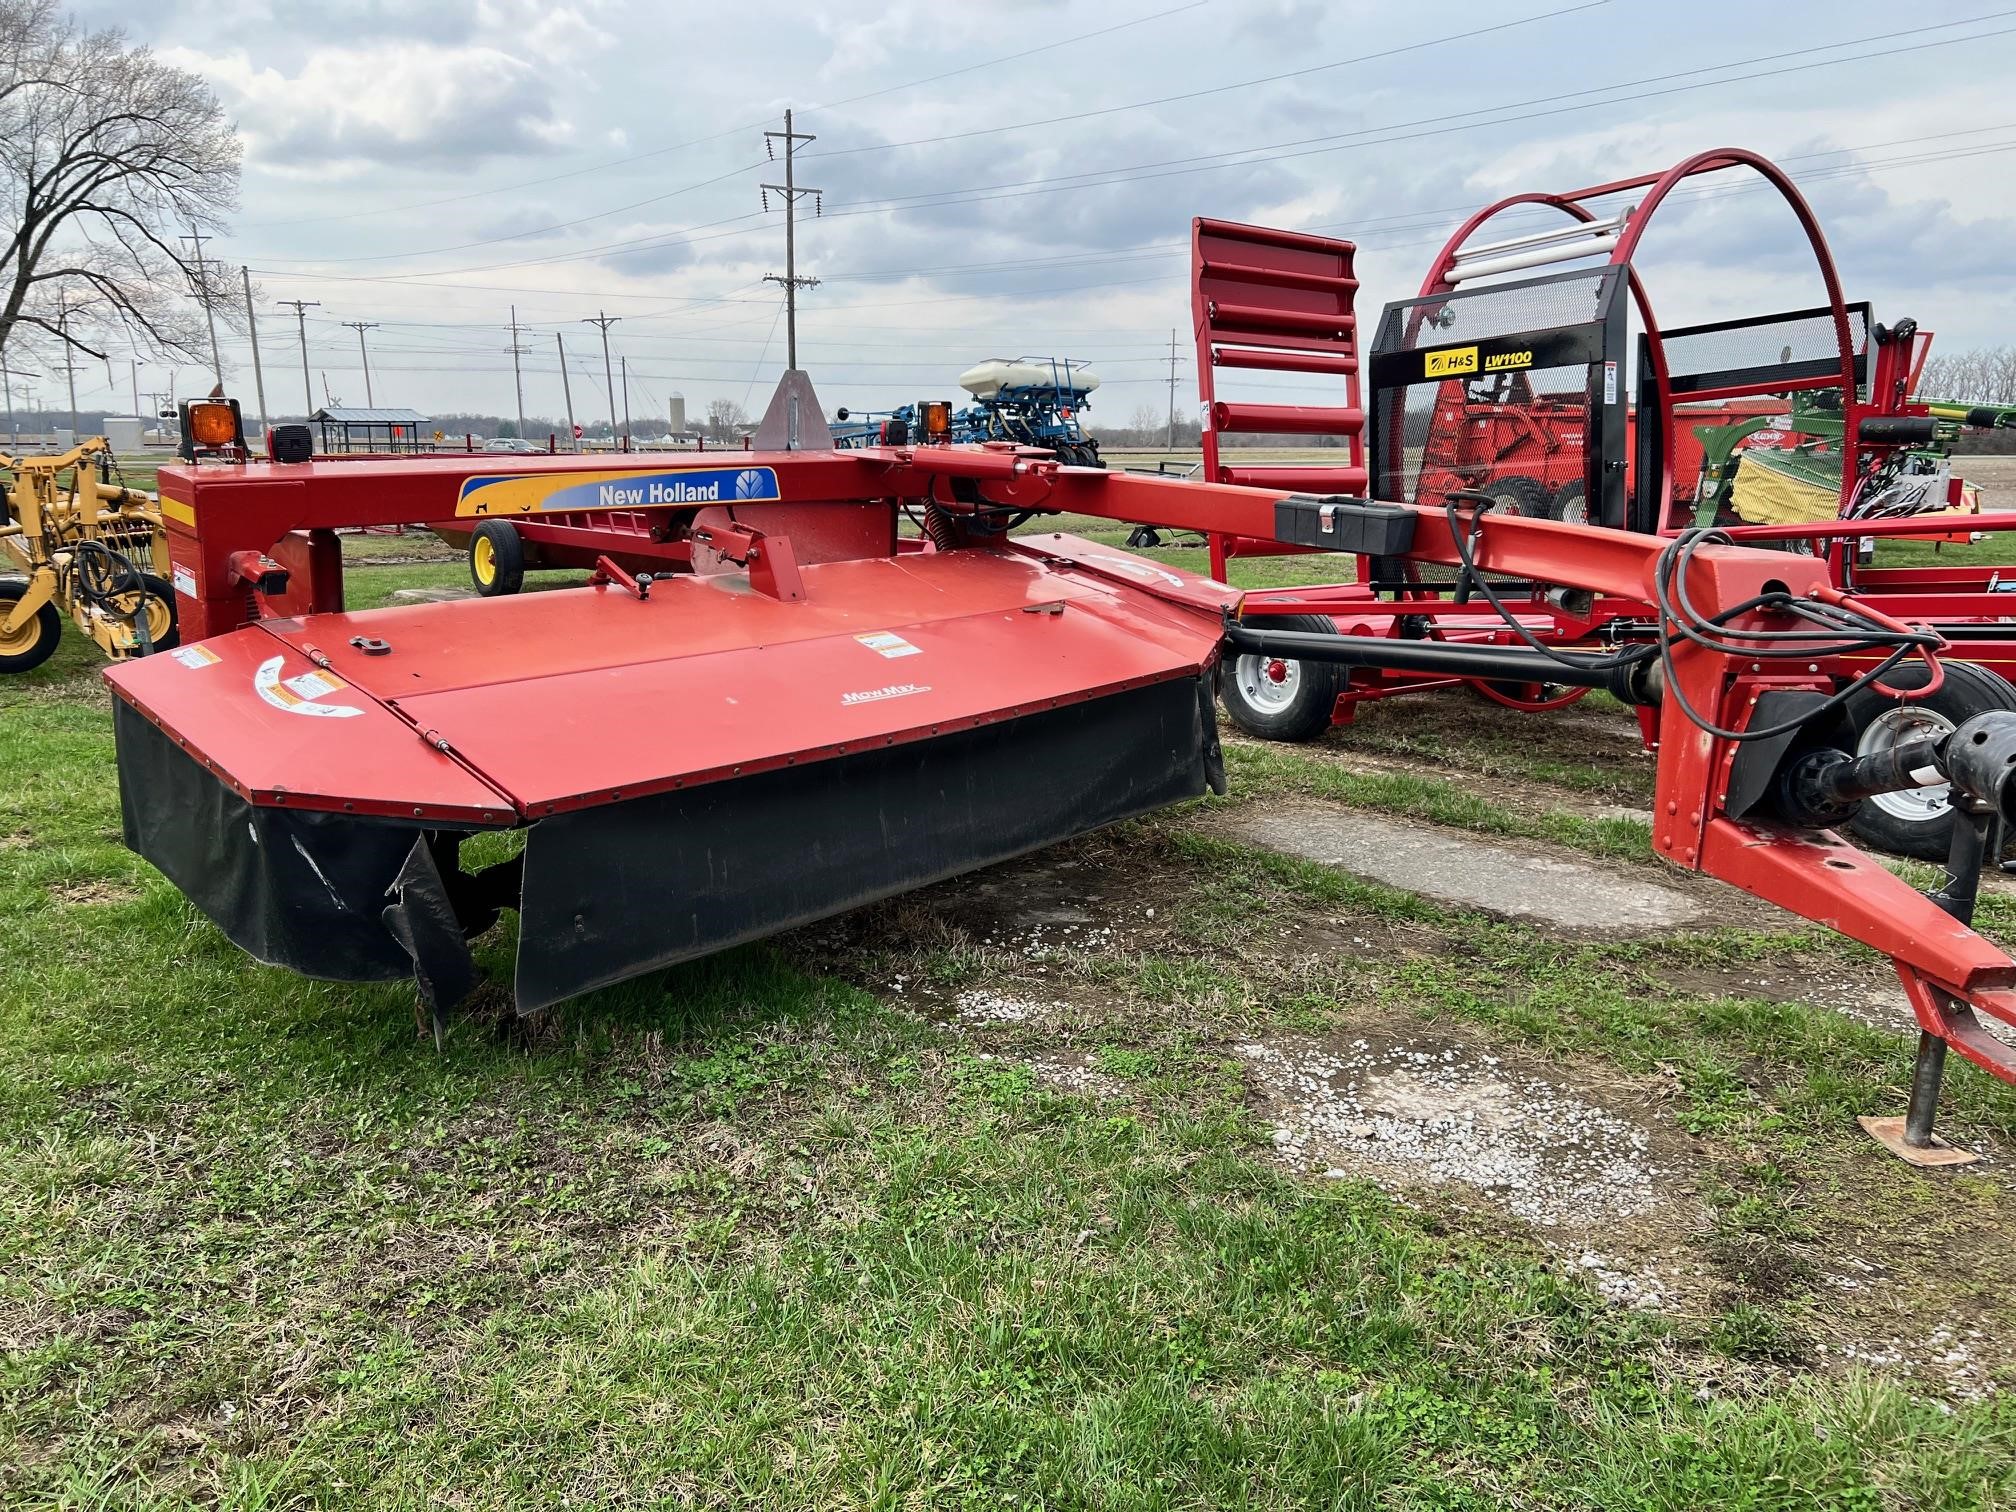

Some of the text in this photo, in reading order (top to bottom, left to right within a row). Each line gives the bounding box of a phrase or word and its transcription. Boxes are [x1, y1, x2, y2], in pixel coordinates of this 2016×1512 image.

[1448, 354, 1474, 369] H&S
[1484, 350, 1533, 368] LW1100
[599, 480, 719, 506] New Holland
